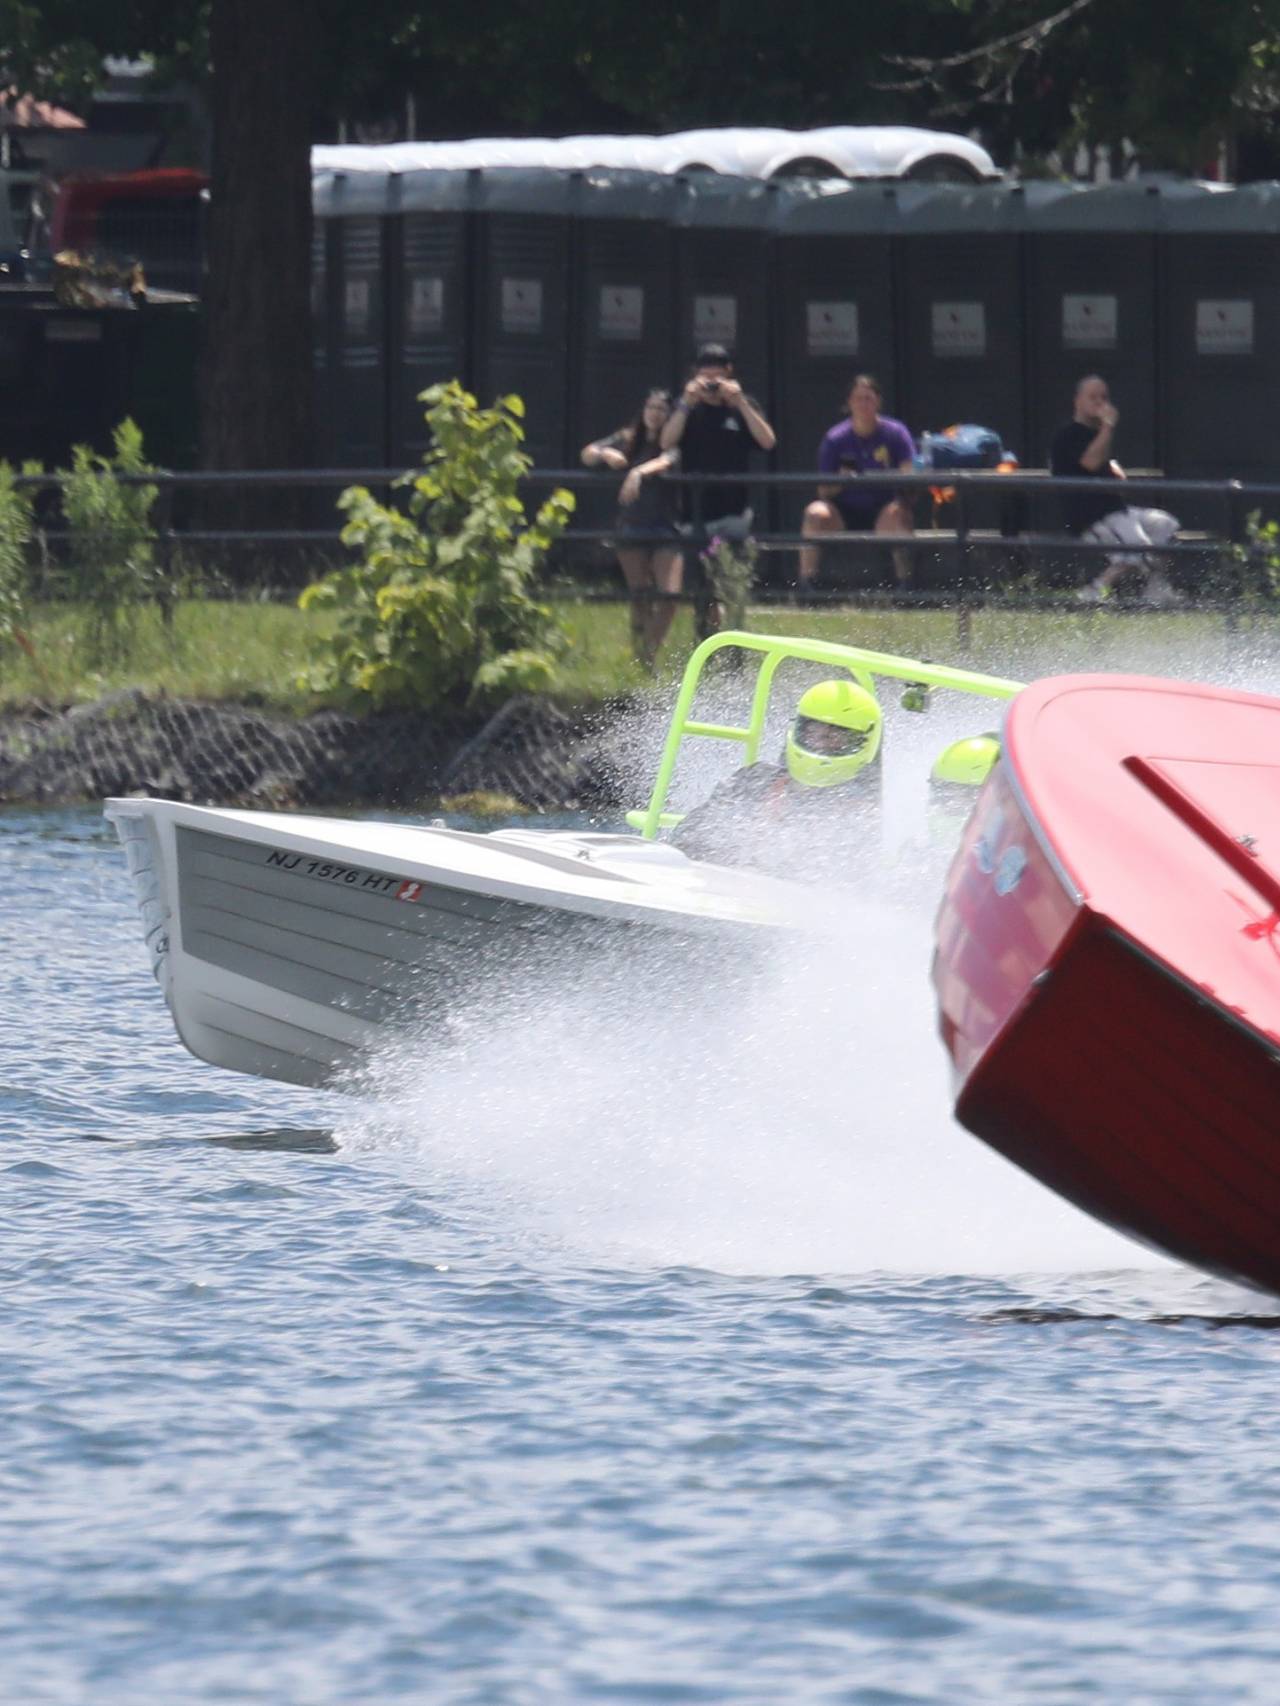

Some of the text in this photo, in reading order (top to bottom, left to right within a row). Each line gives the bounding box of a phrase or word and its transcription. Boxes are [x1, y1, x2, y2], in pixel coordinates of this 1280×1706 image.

[266, 852, 400, 891] NJ 1576 HT
